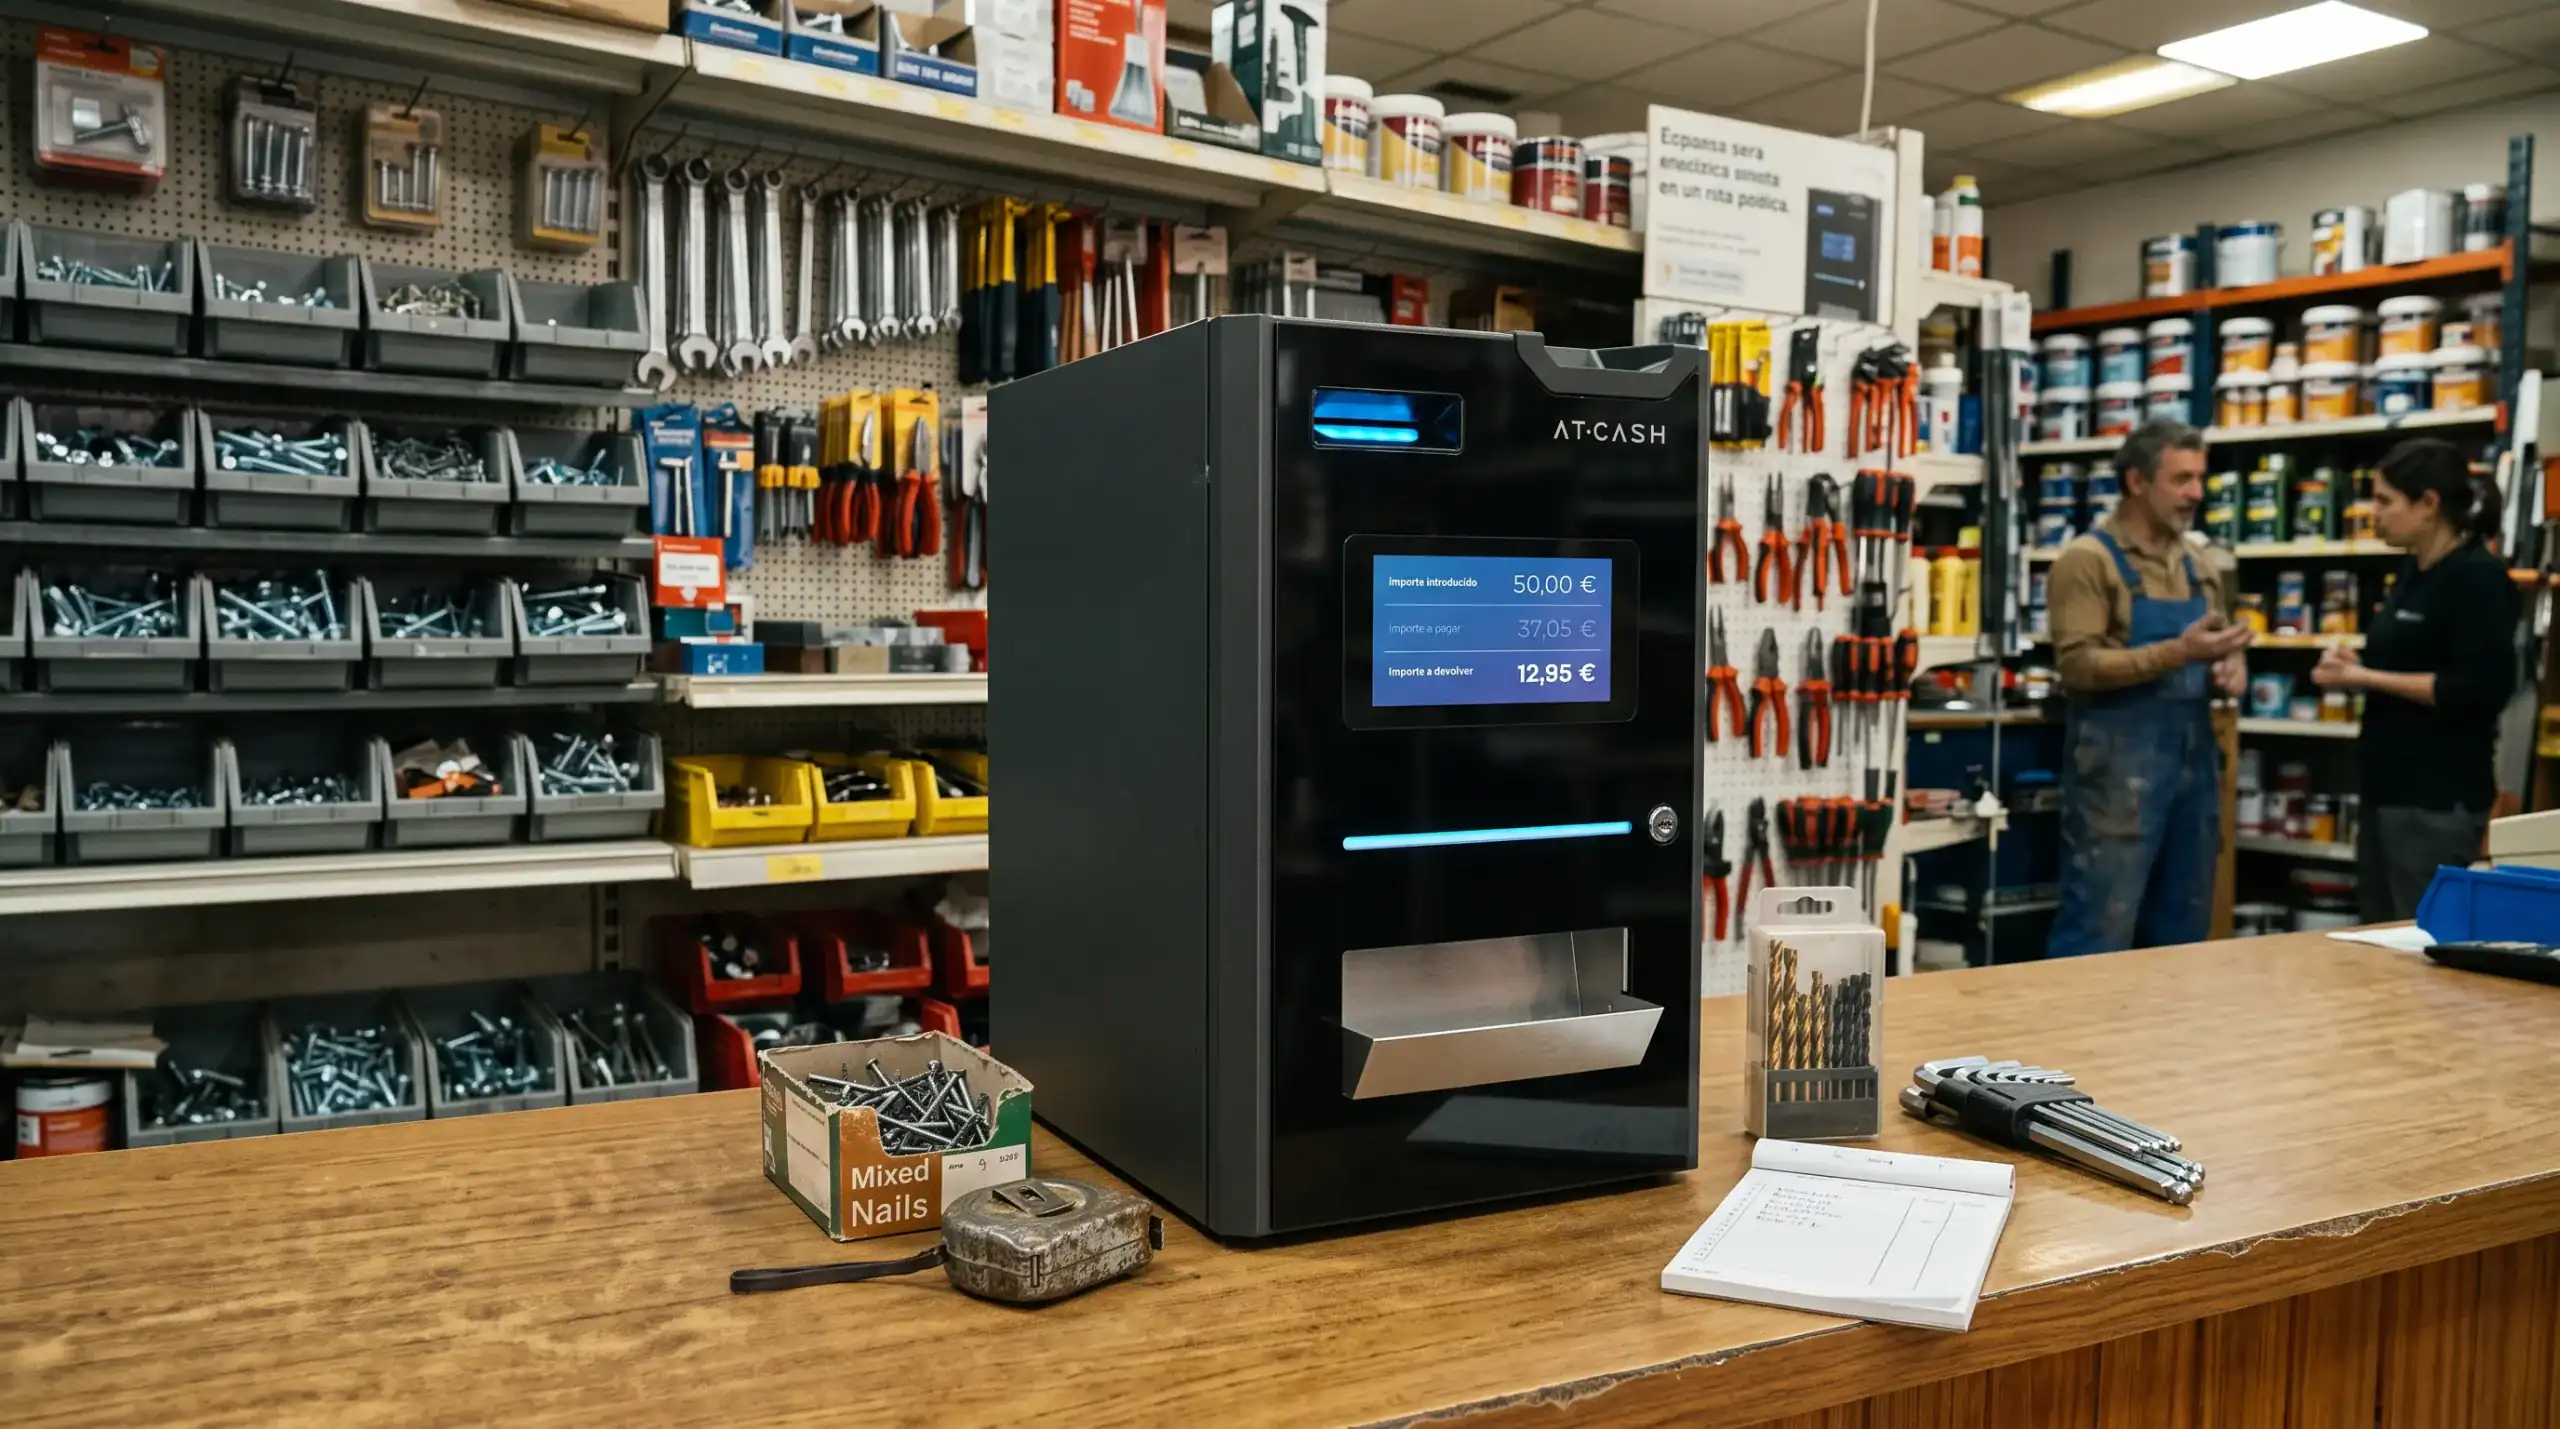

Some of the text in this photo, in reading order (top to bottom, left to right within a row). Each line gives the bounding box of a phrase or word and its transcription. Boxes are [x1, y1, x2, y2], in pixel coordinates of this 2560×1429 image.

[1426, 576, 1478, 588] introducido
[1513, 575, 1573, 596] 50,00
[1580, 575, 1597, 594] €
[1389, 619, 1597, 642] Importe a pagar 37,05 €
[1388, 662, 1597, 686] Importe a devolver 12,95 €
[851, 1157, 930, 1191] Mixed
[851, 1194, 929, 1228] Nails
